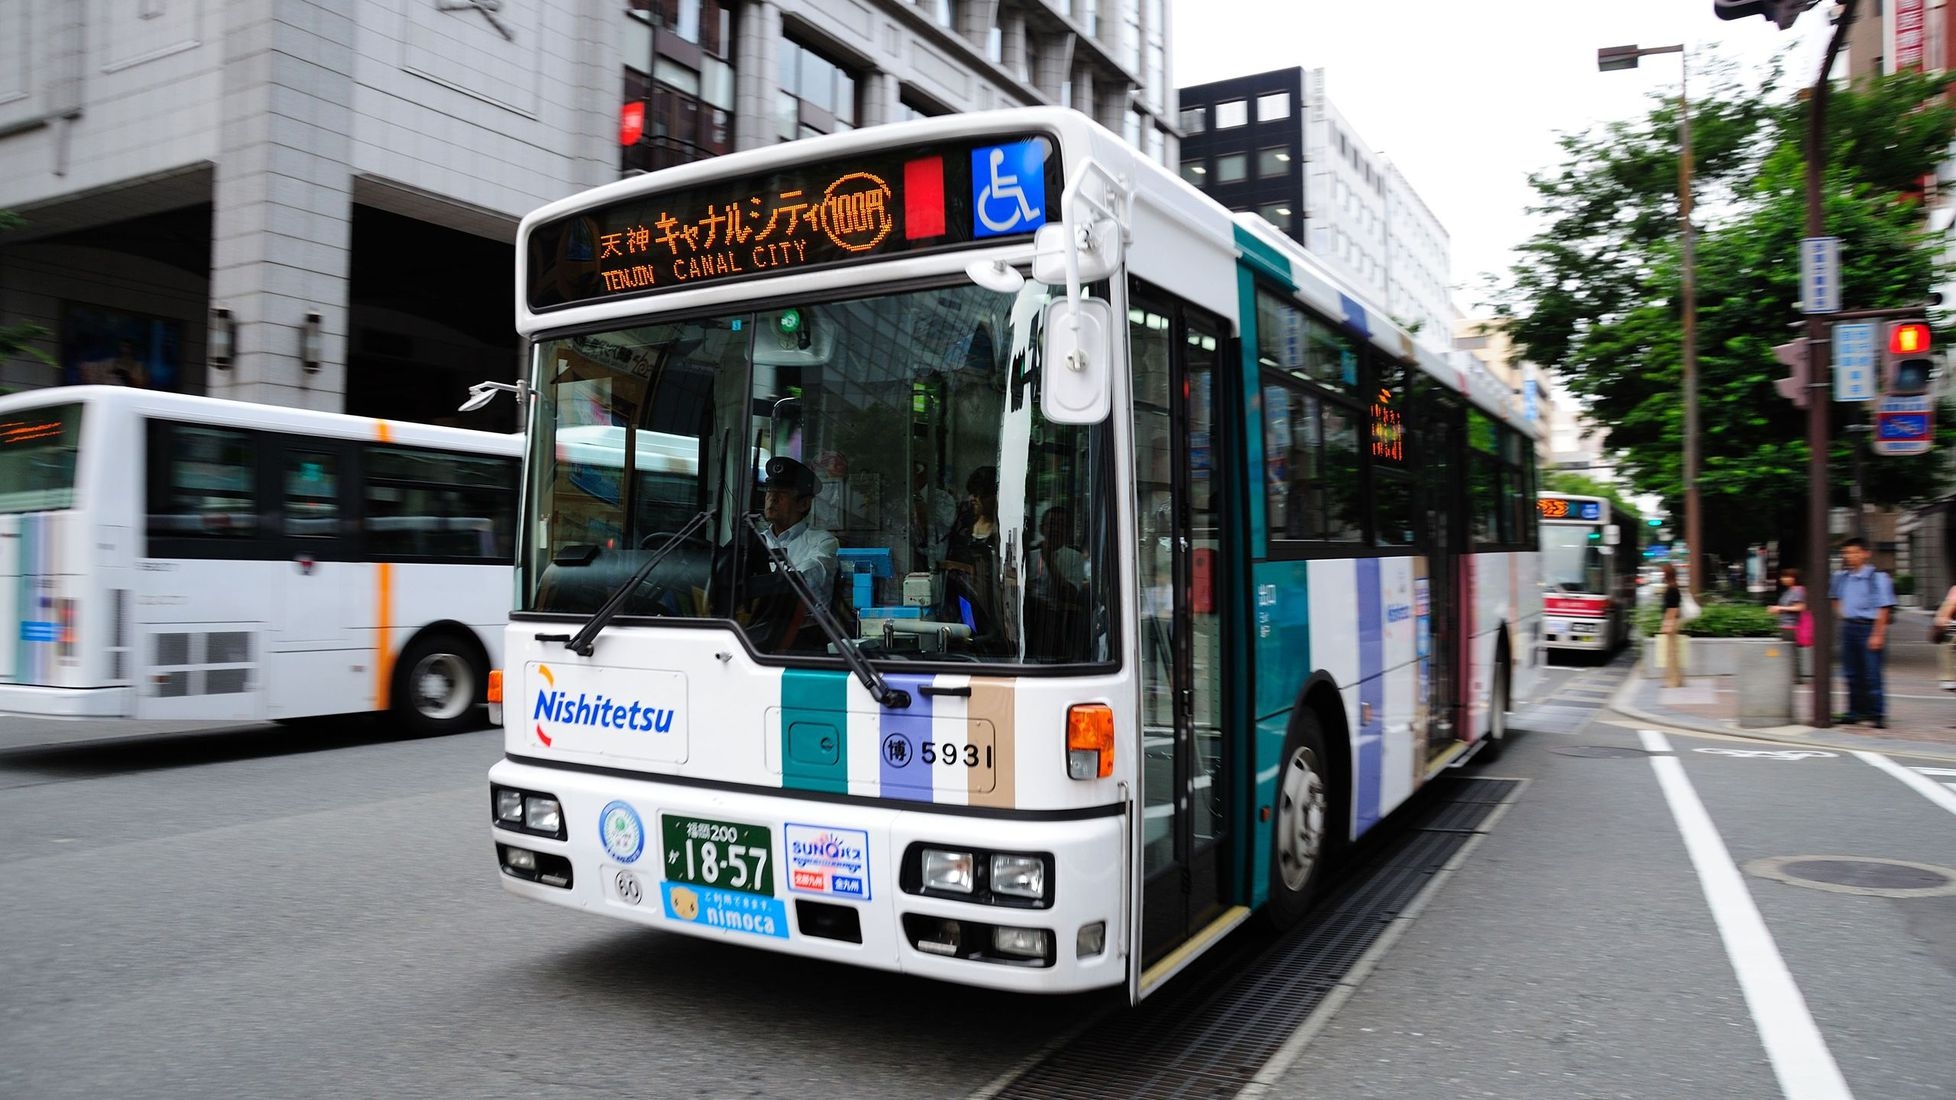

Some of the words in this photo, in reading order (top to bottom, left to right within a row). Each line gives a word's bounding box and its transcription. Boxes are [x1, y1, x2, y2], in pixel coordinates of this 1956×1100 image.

[600, 225, 650, 259] 天神
[655, 190, 819, 254] キャナルシティ
[824, 184, 889, 239] 100円
[601, 263, 654, 291] TENJIN
[673, 251, 742, 280] CANAL
[752, 239, 806, 268] CITY
[533, 689, 674, 733] Nishitetsu
[886, 737, 909, 764] 博
[921, 741, 992, 769] 5931
[685, 839, 768, 891] 18-57
[706, 906, 776, 934] nimoca
